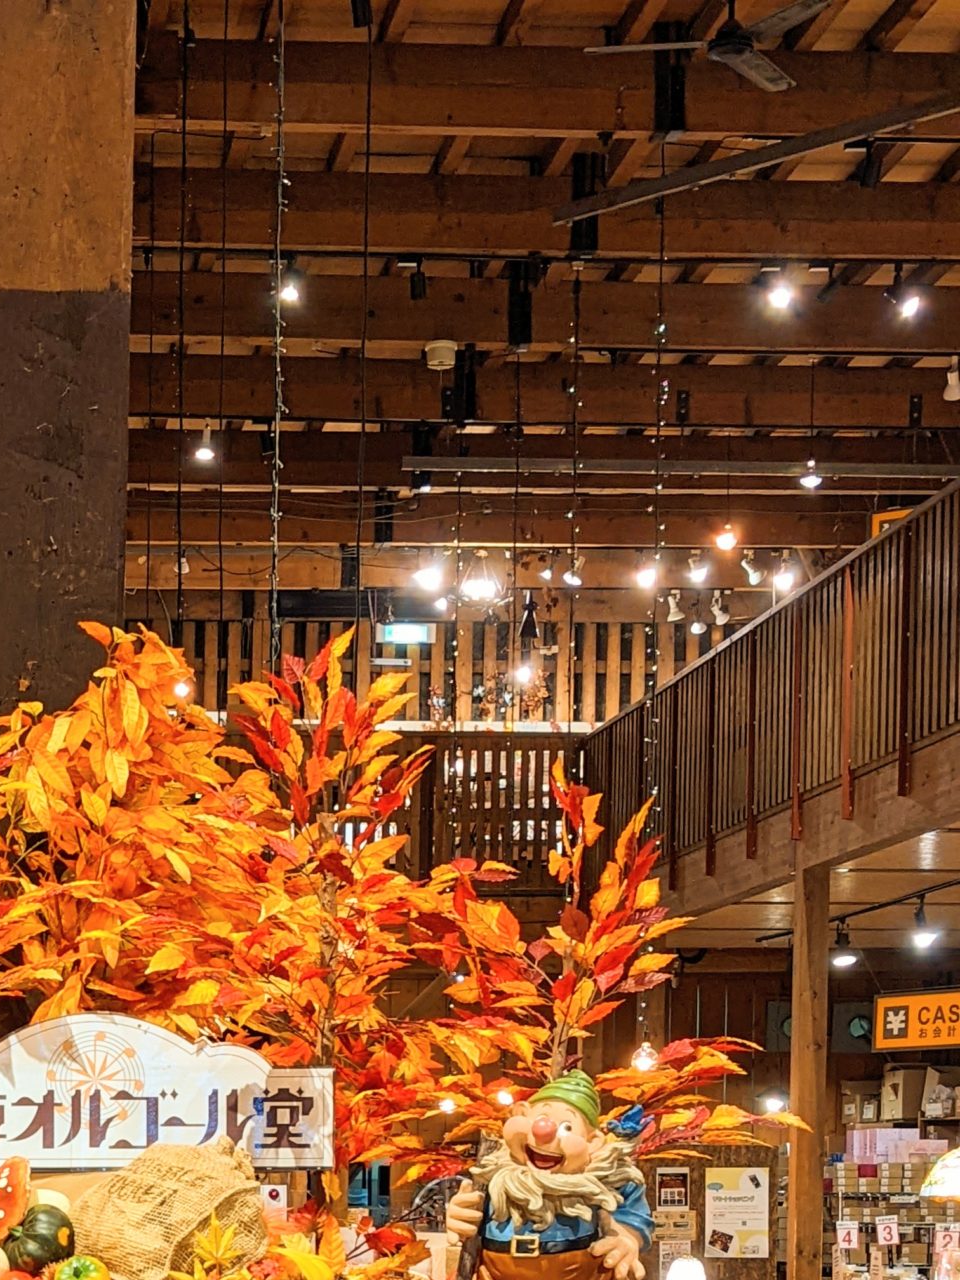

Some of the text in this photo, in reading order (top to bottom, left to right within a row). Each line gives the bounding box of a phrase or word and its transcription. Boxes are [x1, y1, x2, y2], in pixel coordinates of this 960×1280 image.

[918, 1025, 956, 1038] お会計
[842, 1230, 853, 1246] 4
[882, 1225, 893, 1242] 3
